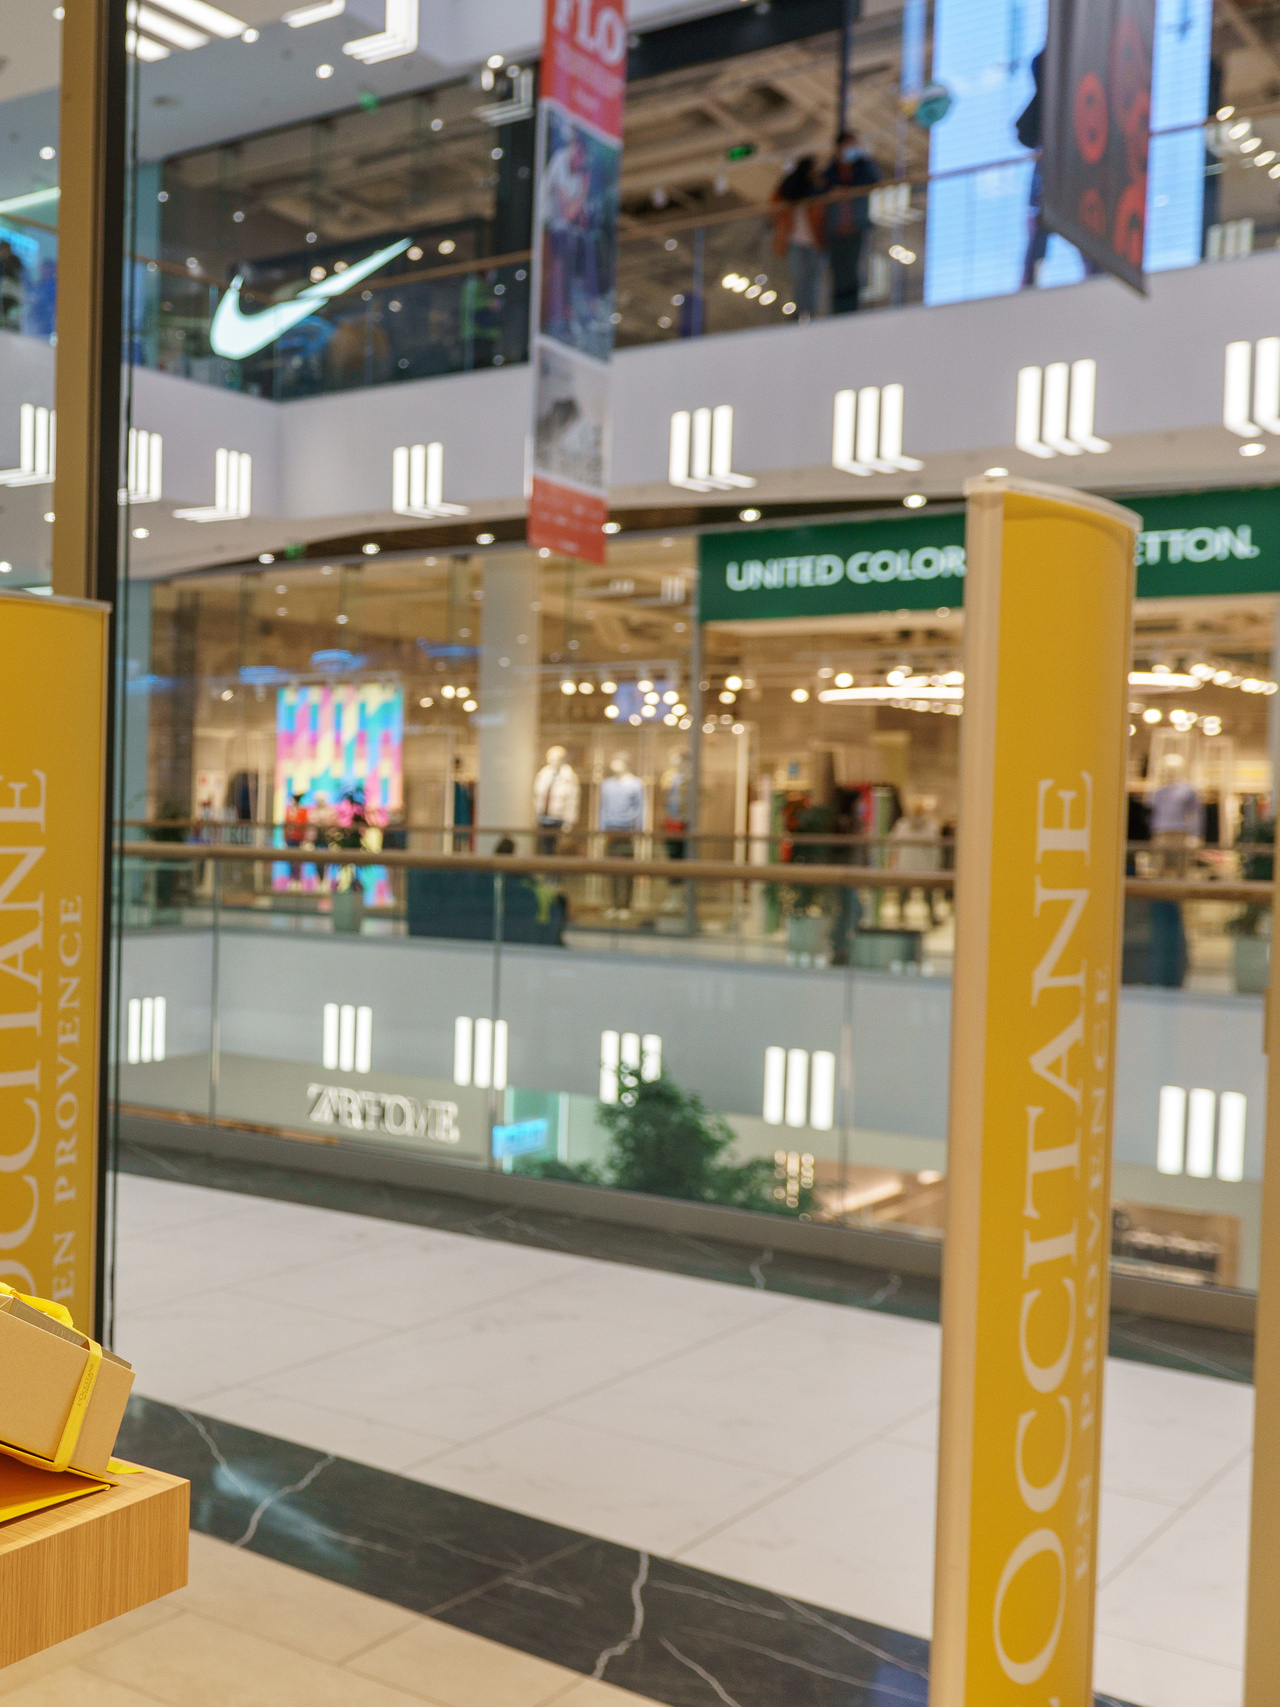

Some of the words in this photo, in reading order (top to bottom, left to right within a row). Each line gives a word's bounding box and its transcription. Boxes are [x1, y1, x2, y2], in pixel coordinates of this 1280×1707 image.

[1134, 524, 1260, 566] TTON.
[726, 553, 844, 591] UNITED
[55, 895, 82, 1206] PROVENCE
